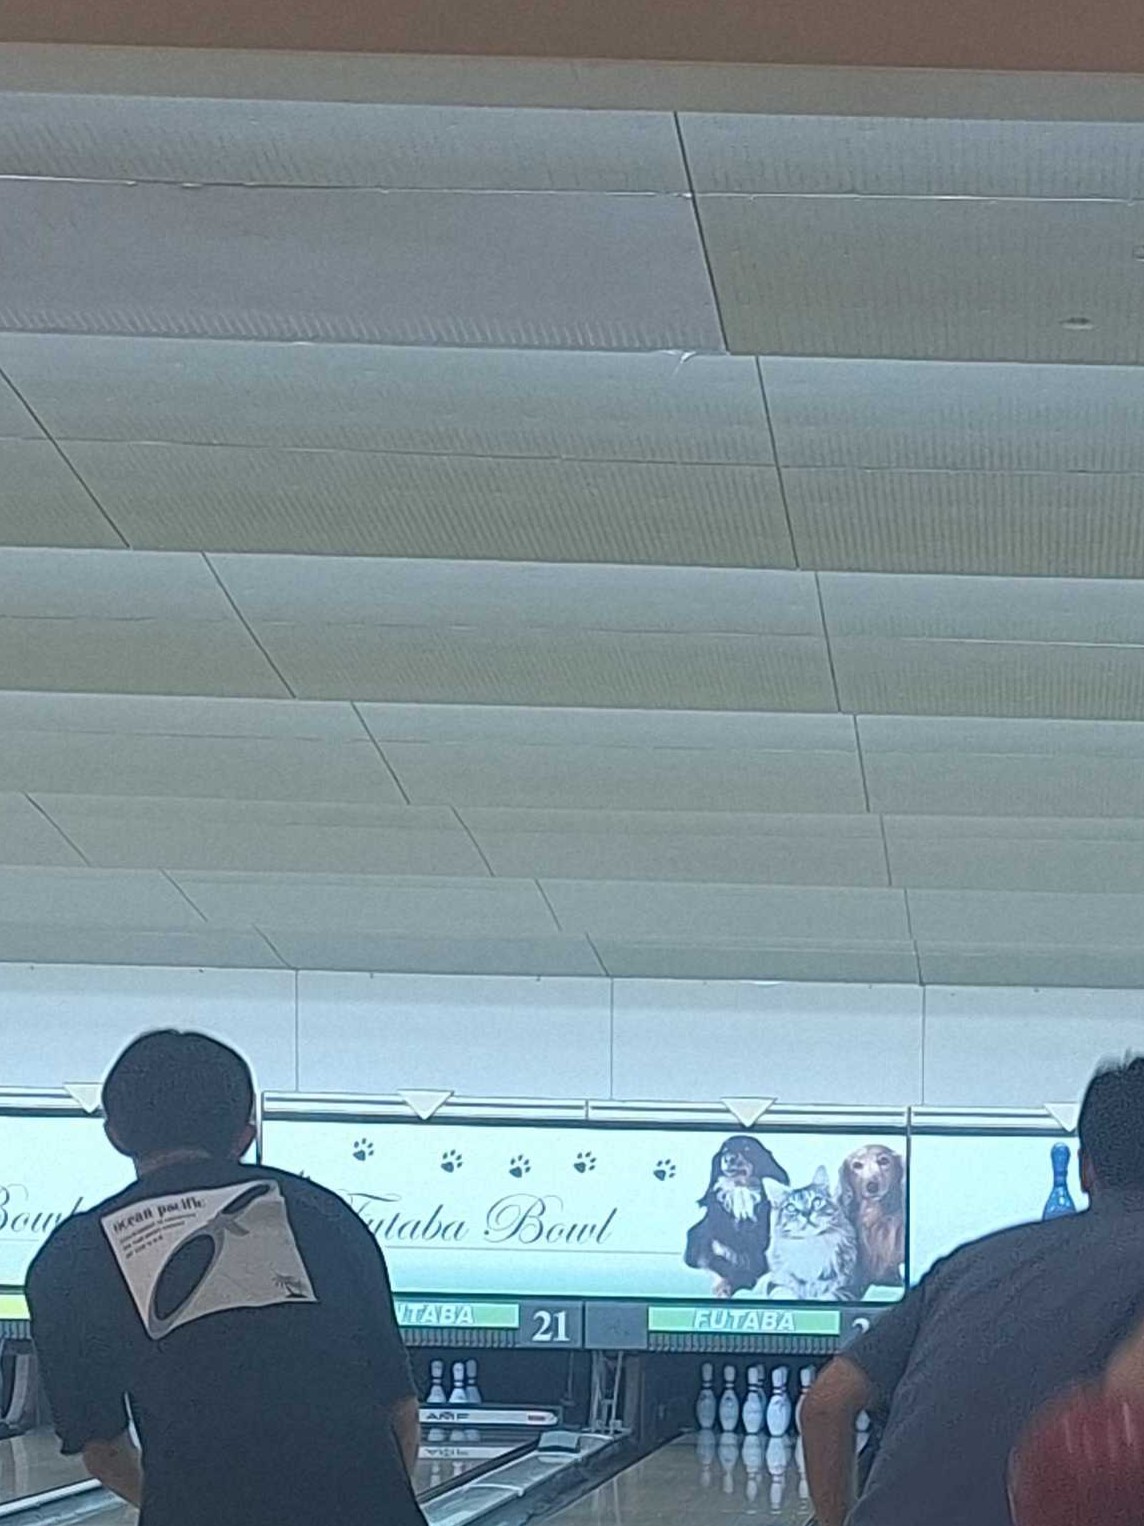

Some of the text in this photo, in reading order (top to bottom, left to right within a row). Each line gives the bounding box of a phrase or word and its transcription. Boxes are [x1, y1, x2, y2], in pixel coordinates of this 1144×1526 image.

[112, 1196, 206, 1233] ocean pacific
[483, 1193, 618, 1245] Bowl
[400, 1303, 474, 1325] TABA
[531, 1310, 570, 1342] 21
[693, 1309, 796, 1331] FUTABA
